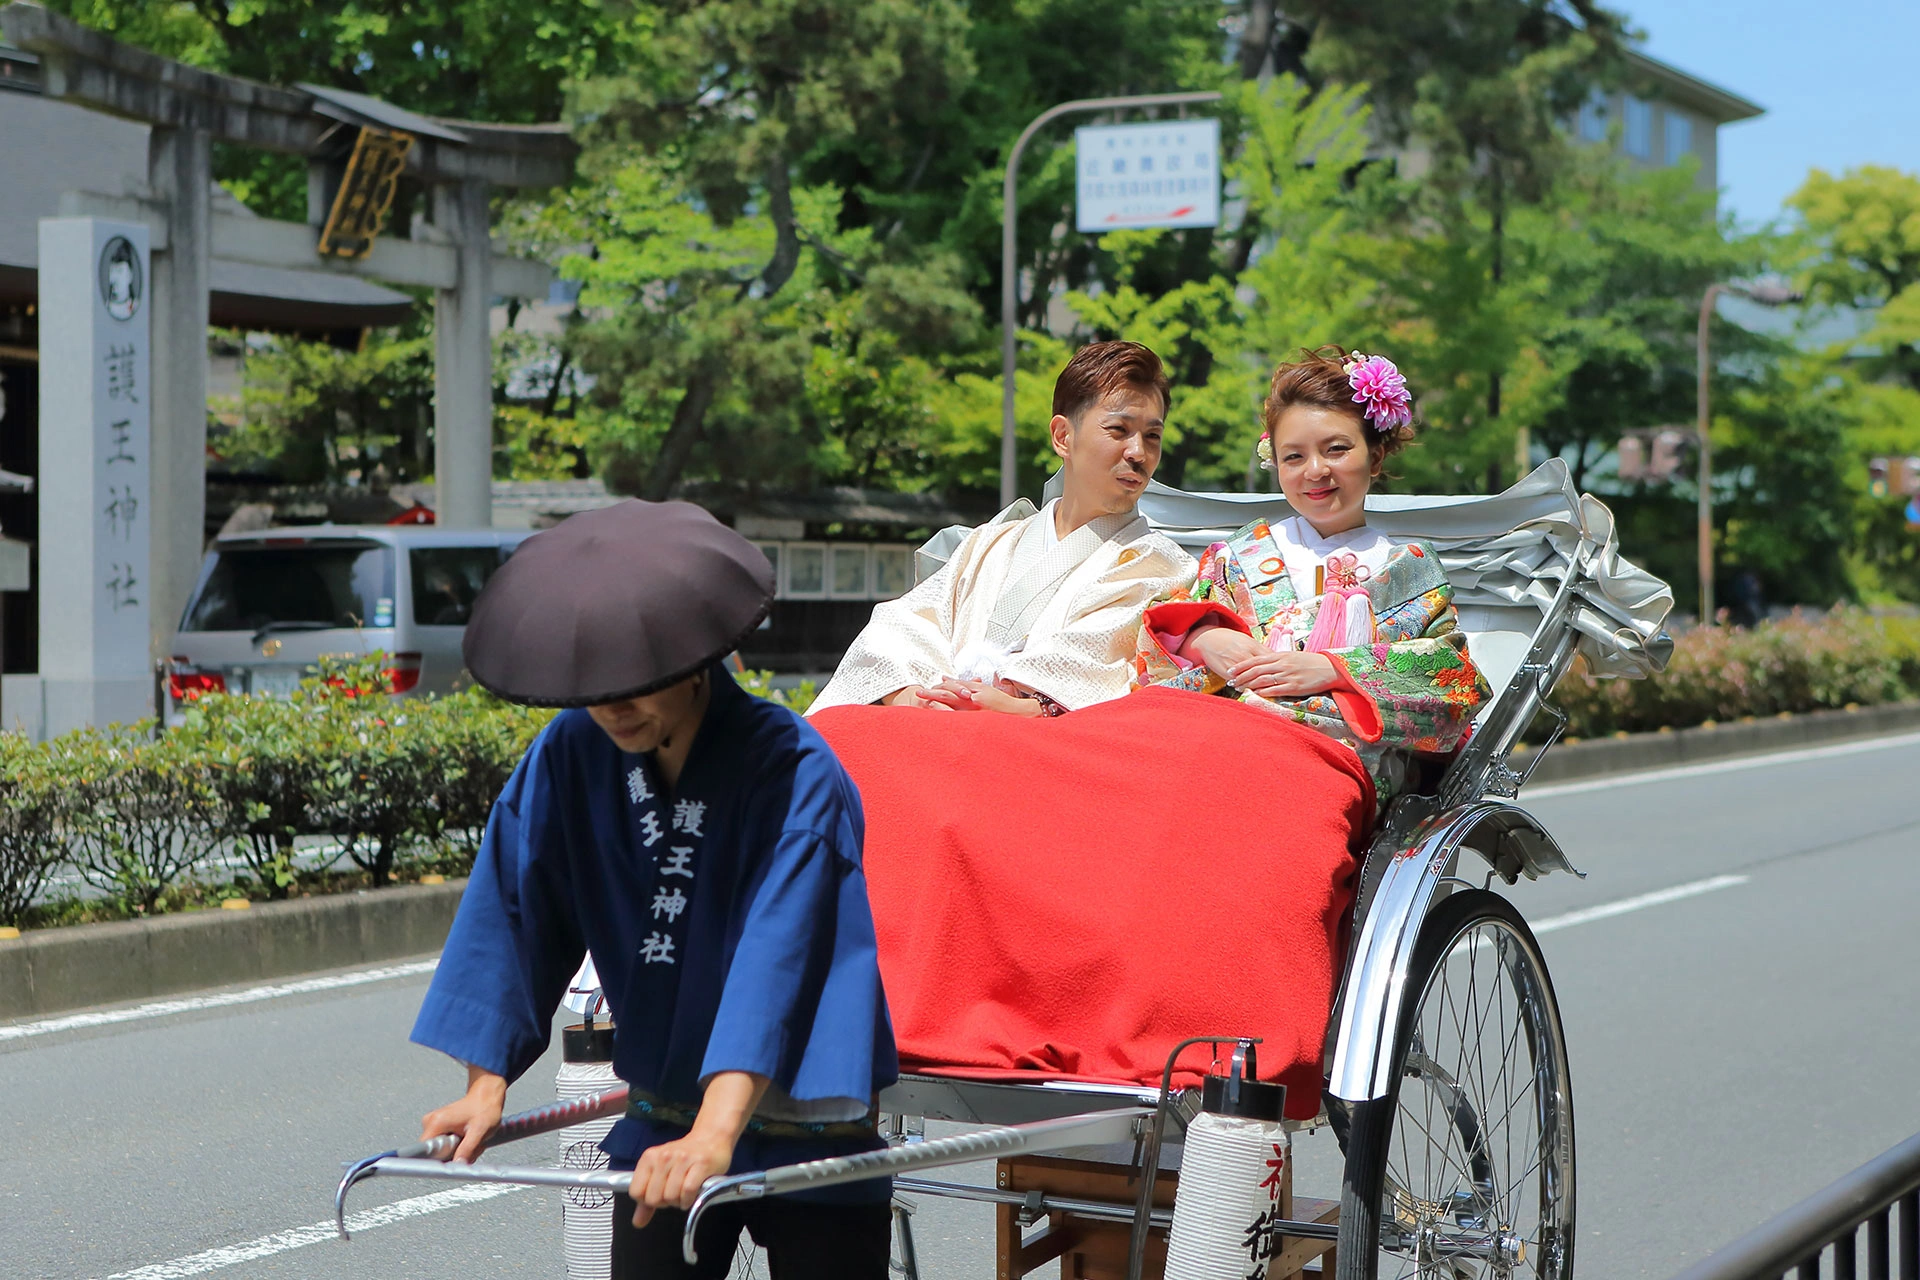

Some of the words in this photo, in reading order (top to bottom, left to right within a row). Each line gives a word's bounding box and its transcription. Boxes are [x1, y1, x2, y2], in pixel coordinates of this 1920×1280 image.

[104, 342, 139, 612] 護王神社
[627, 767, 664, 861] 護王
[639, 798, 707, 964] 護王神社
